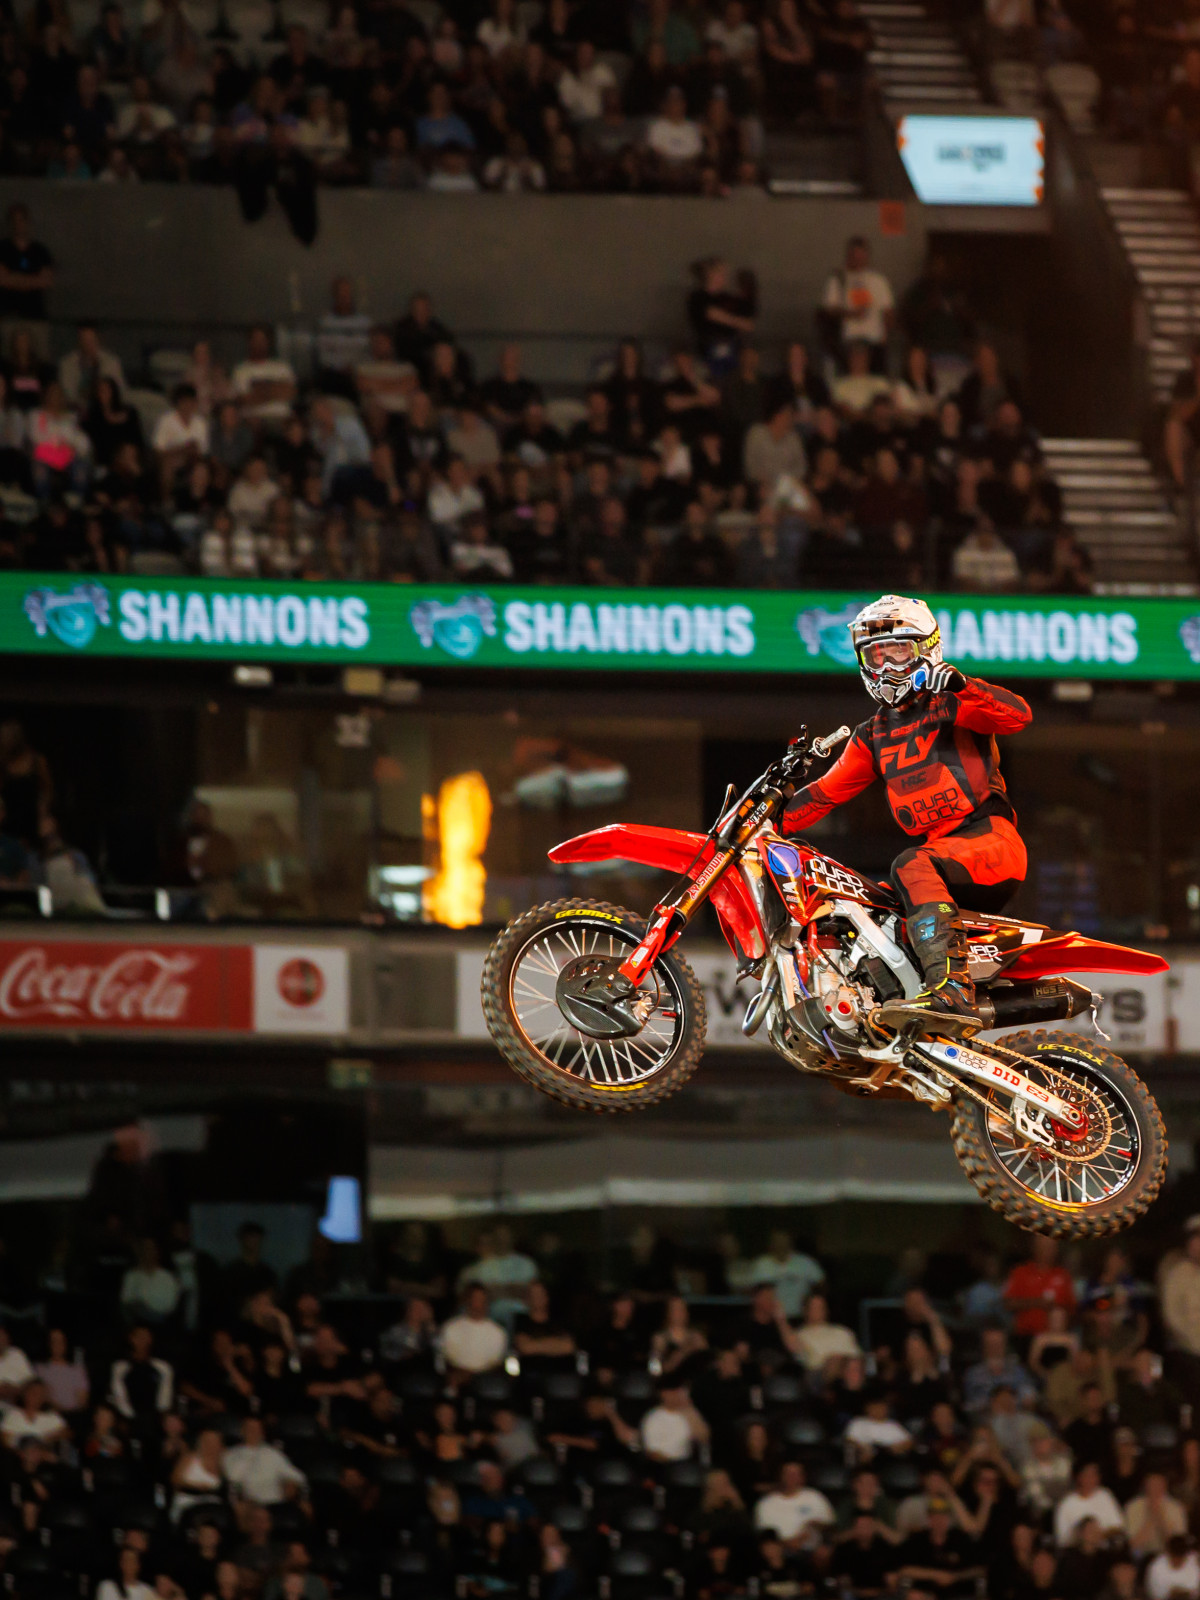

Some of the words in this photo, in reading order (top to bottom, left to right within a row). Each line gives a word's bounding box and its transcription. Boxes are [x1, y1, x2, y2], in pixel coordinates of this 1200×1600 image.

[118, 590, 371, 648] SHANNONS
[503, 596, 756, 657] SHANNONS
[880, 729, 940, 774] FLY
[912, 787, 959, 814] QUAD
[915, 800, 964, 826] LOCK
[696, 851, 726, 888] SHOWA
[809, 858, 865, 888] QUAD
[812, 871, 869, 902] LOCK
[554, 908, 624, 926] GEOMAX
[960, 1050, 988, 1066] QUAD
